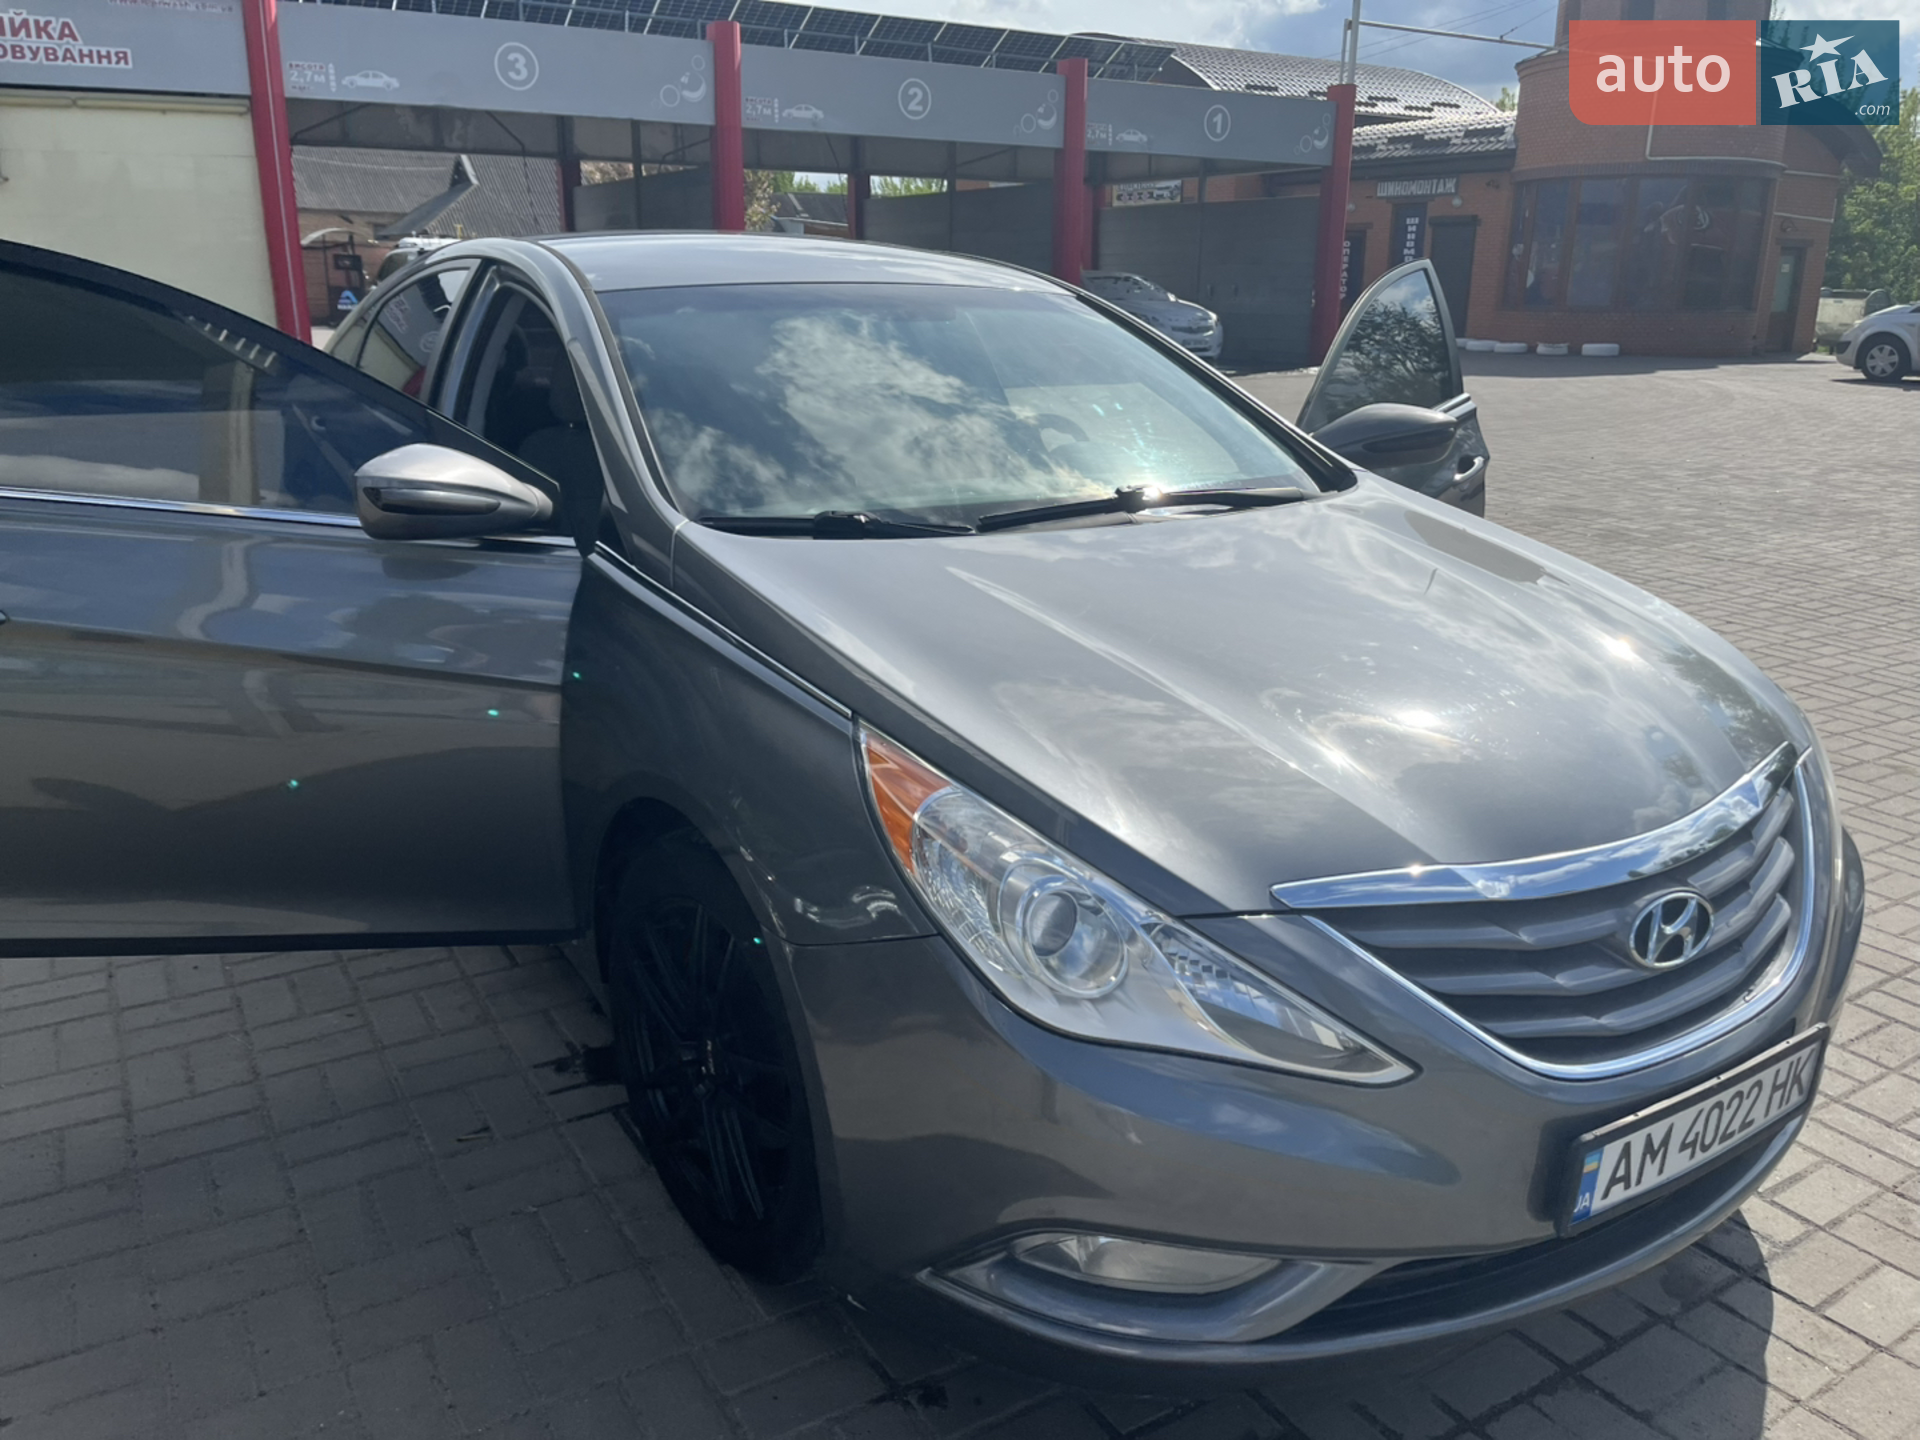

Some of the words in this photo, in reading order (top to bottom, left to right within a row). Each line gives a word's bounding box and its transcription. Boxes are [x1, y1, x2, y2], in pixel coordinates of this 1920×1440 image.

[507, 52, 529, 81] 3
[907, 87, 923, 112] 2
[1212, 112, 1223, 134] 1
[1376, 177, 1457, 197] ШИНОМОНТАЖ
[1600, 1122, 1674, 1201] AM
[1678, 1079, 1763, 1161] 4022
[1764, 1047, 1816, 1119] HK
